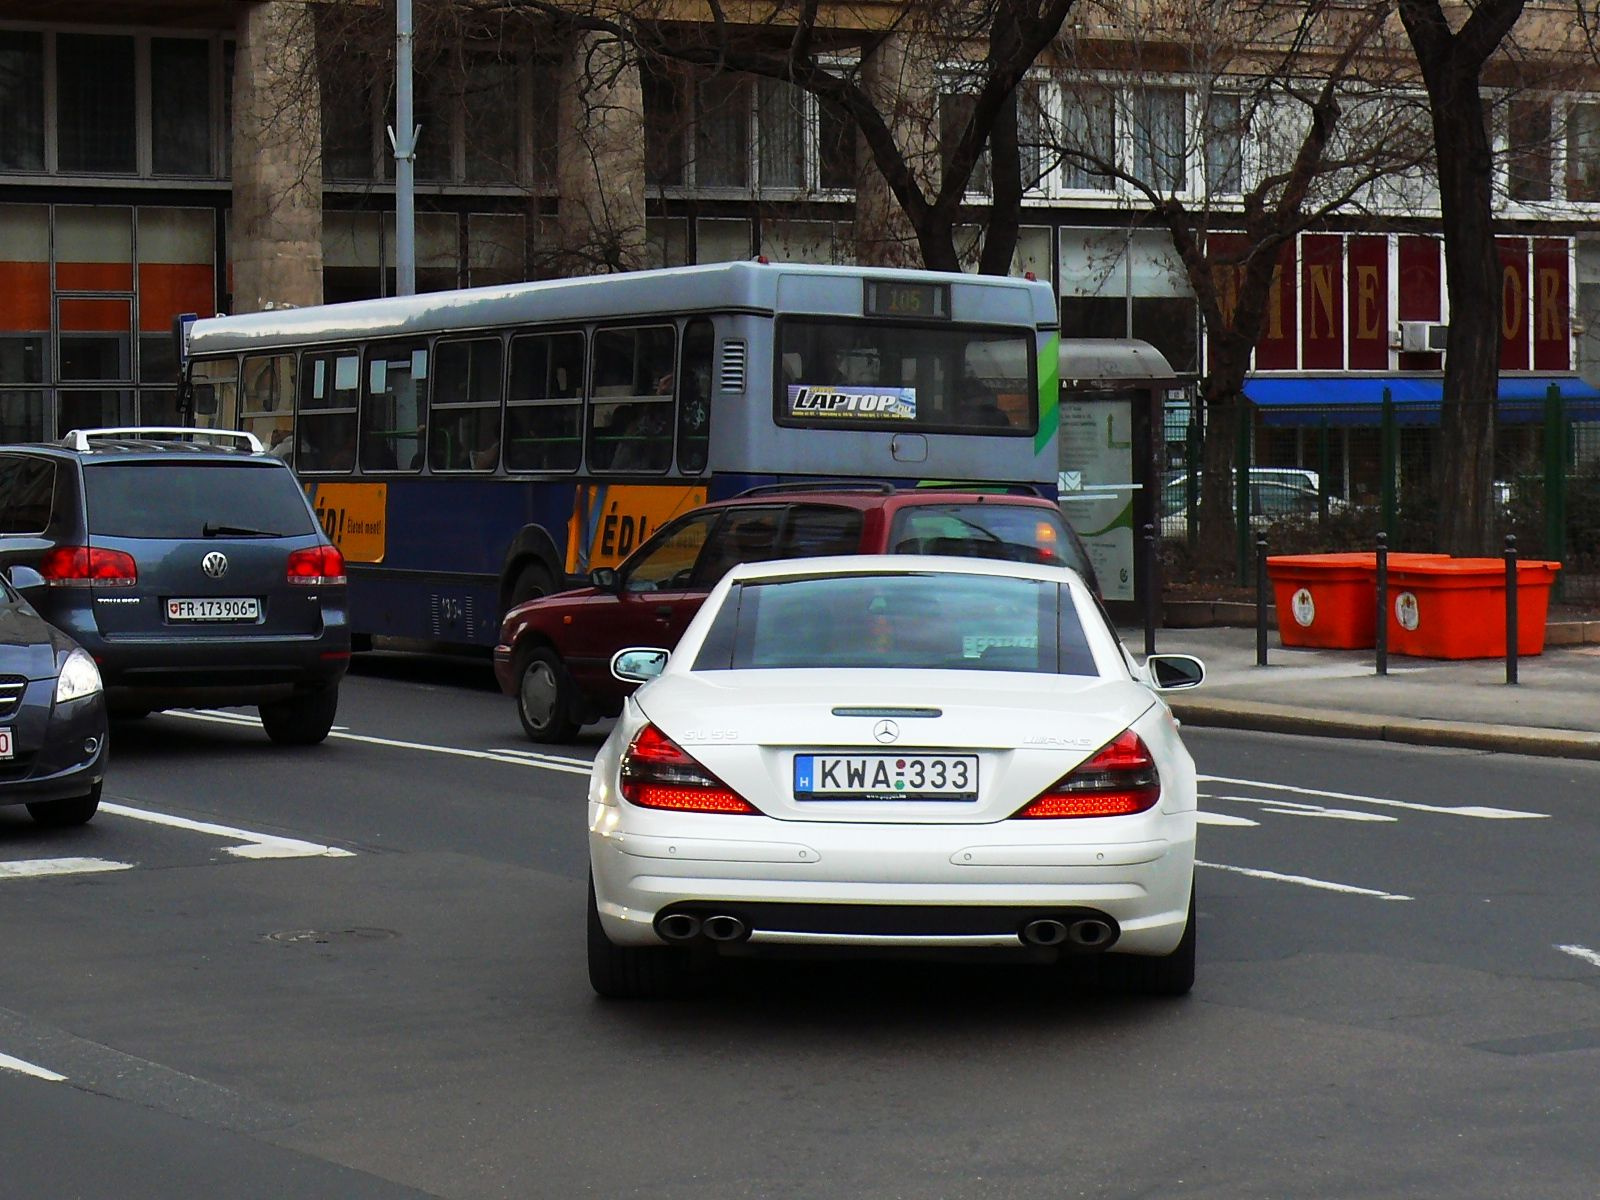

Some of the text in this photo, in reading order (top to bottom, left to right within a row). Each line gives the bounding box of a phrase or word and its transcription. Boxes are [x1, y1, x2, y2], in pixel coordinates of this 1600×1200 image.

[890, 288, 920, 311] 105
[794, 386, 896, 410] LAPTOP
[799, 777, 809, 787] H
